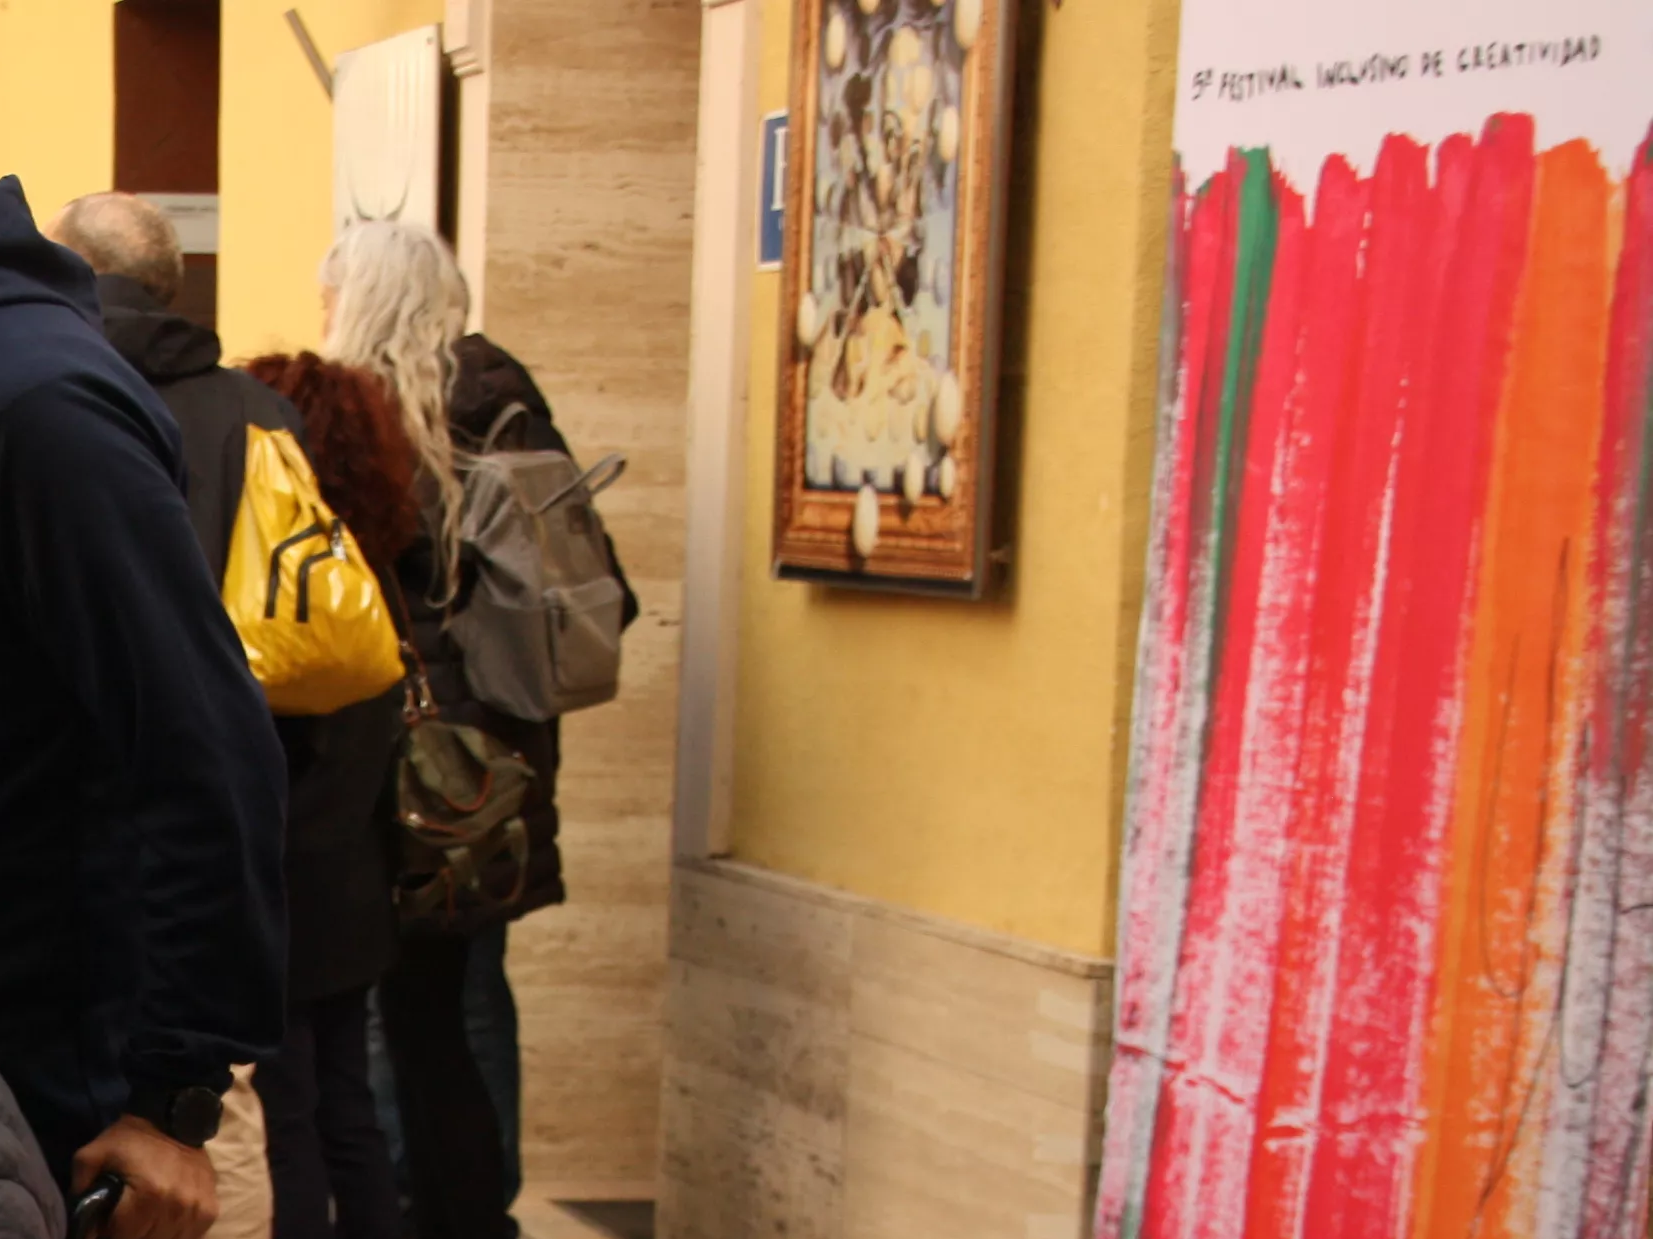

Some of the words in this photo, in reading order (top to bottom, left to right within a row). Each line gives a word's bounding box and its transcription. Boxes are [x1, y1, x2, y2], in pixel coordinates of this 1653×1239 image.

[1218, 63, 1304, 101] FESTIVAL
[1317, 53, 1409, 89] INCLUSIVO
[1420, 52, 1443, 78] DE
[1457, 34, 1601, 73] CREATIVIDAD
